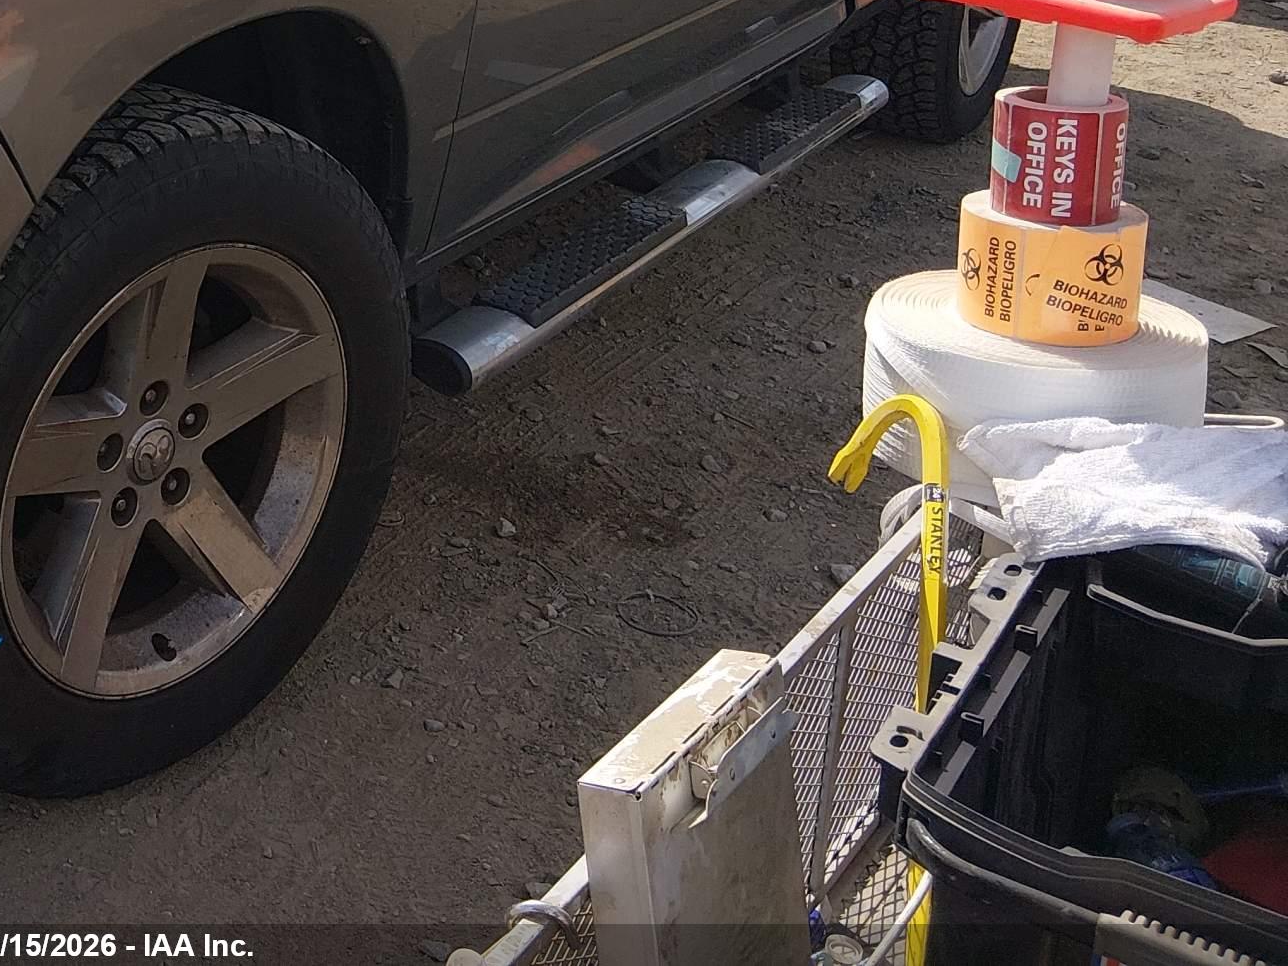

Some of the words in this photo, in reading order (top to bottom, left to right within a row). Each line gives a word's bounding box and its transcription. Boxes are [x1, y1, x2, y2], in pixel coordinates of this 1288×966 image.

[1023, 122, 1047, 208] OFFICE
[1053, 119, 1079, 185] KEYS
[1110, 122, 1127, 210] OFFICE
[1051, 191, 1072, 218] IN
[984, 236, 1000, 318] BIOHAZARD
[999, 239, 1017, 322] BIOPELIGRO
[1046, 294, 1123, 327] BIOPELIGRO
[1052, 279, 1128, 310] BIOHAZARD
[928, 507, 943, 575] STANLEY
